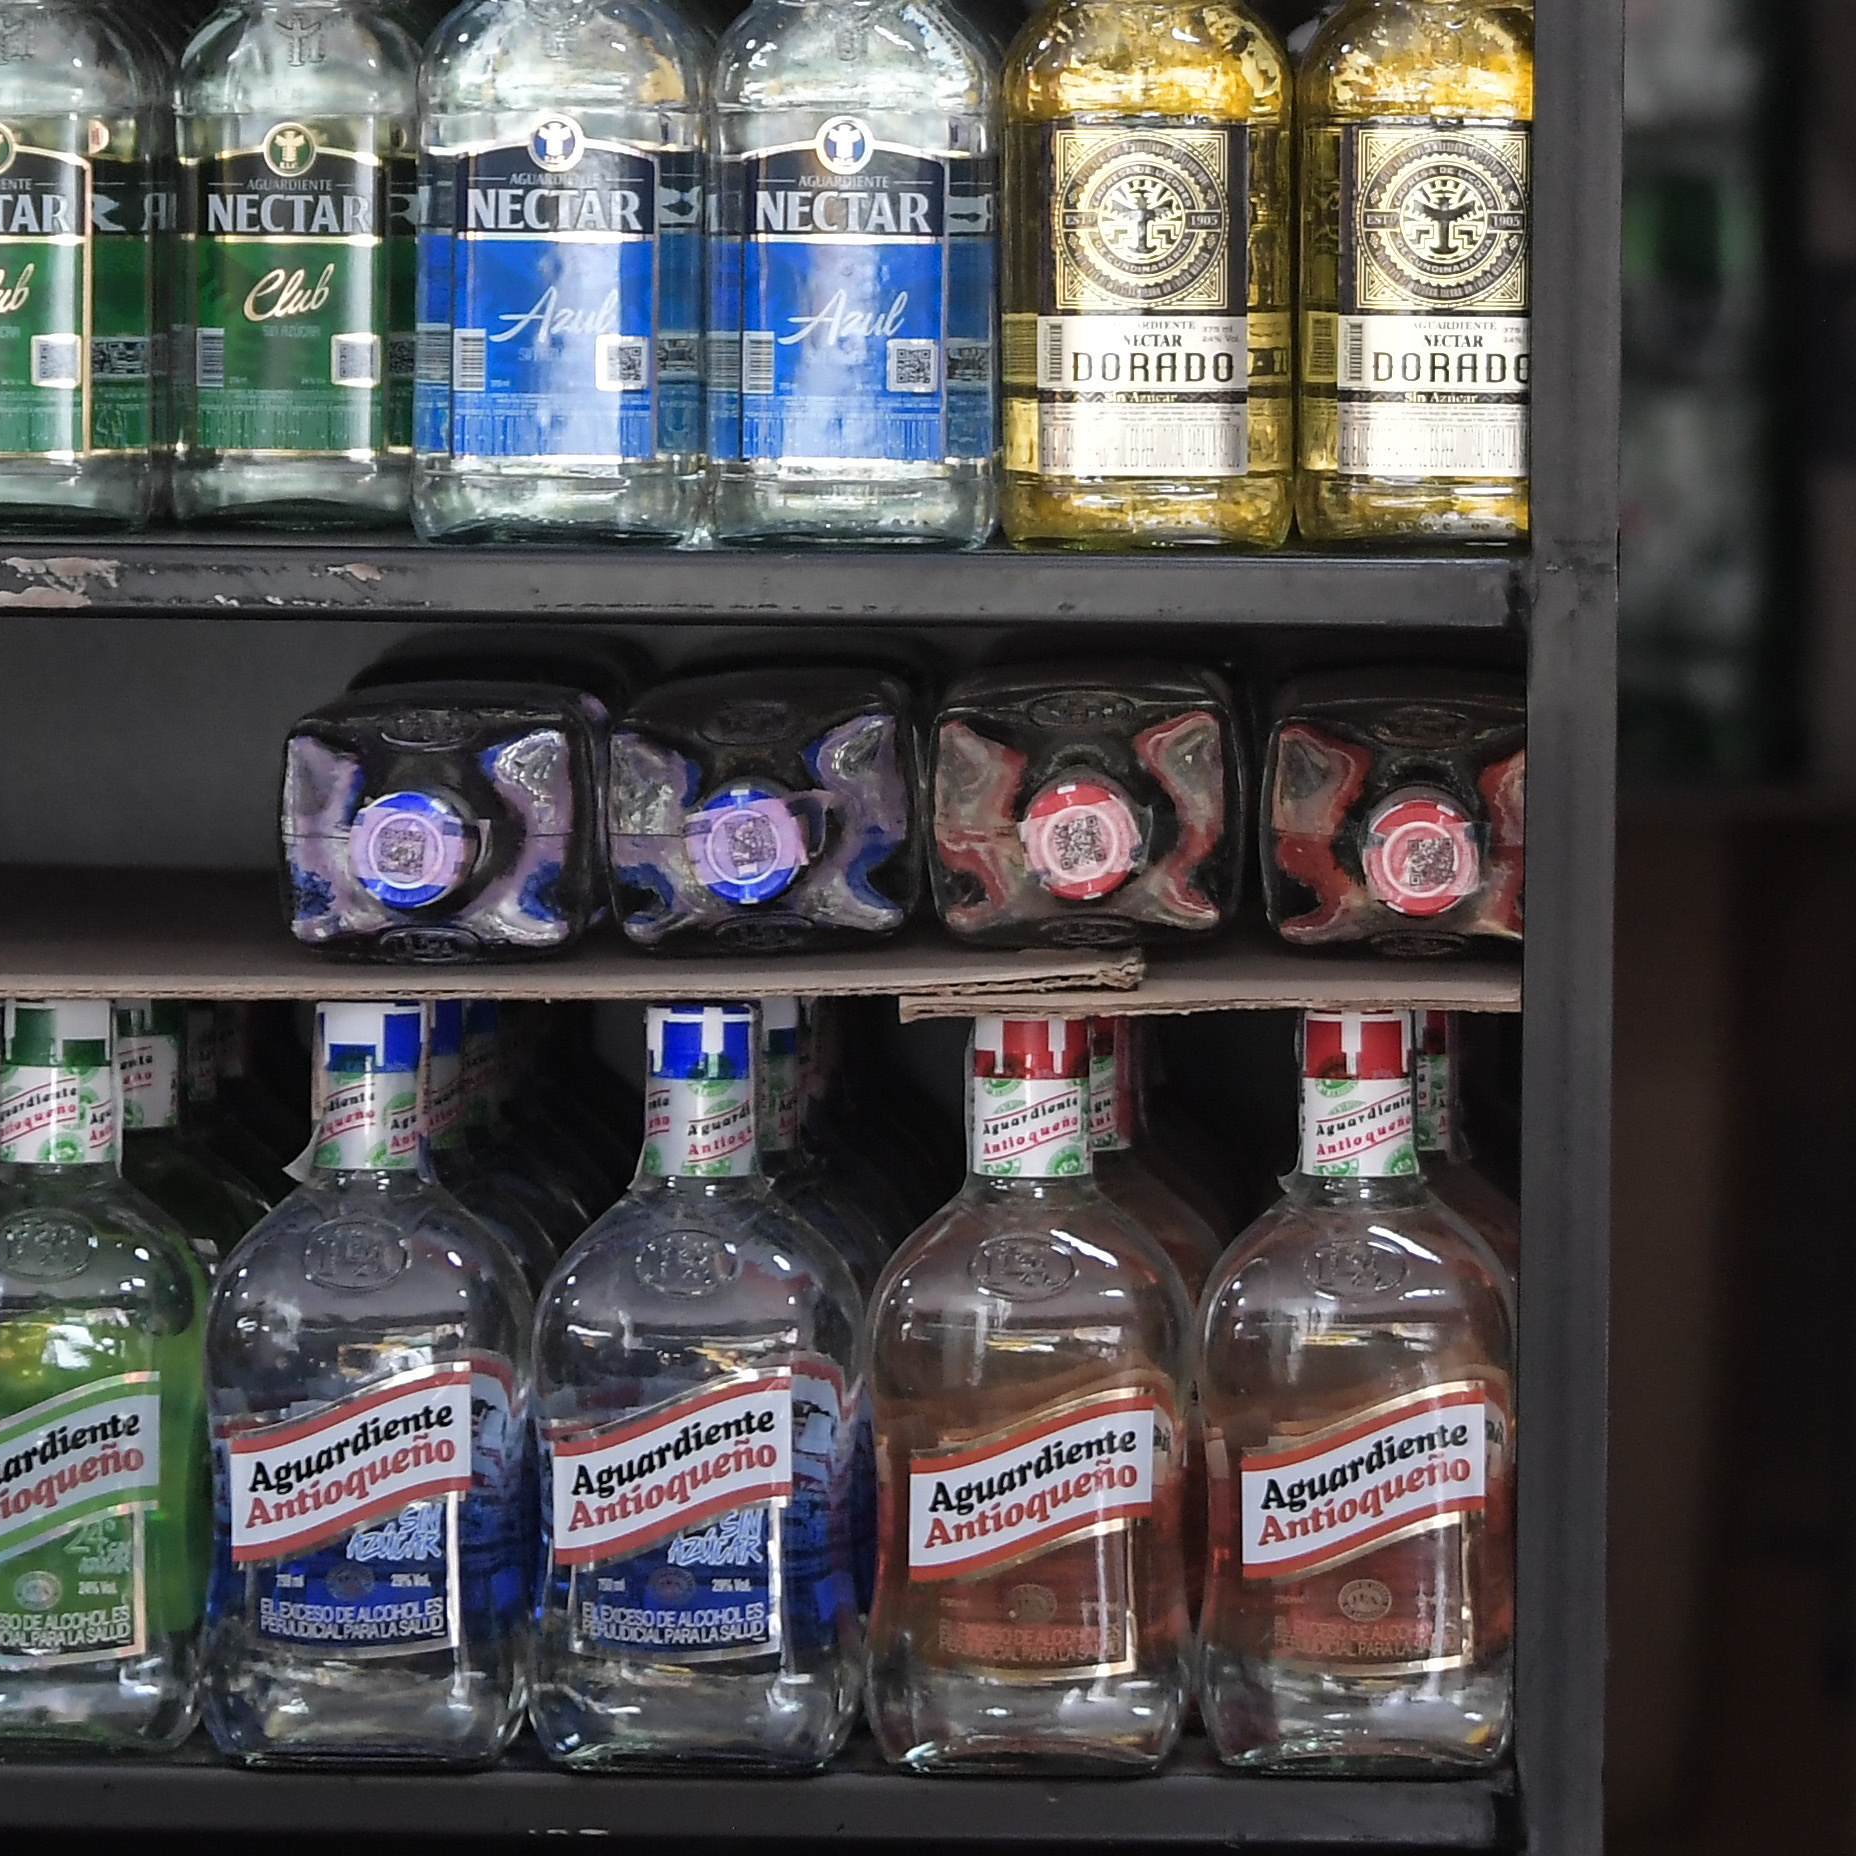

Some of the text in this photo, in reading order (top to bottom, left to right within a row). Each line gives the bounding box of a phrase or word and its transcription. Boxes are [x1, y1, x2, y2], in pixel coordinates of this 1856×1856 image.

[246, 178, 333, 193] AGUARDIENTE
[797, 175, 890, 189] AGUARDIENTE
[1457, 167, 1495, 209] LICORES
[207, 194, 373, 233] NECTAR
[466, 188, 642, 231] NECTAR
[756, 191, 932, 233] NECTAR
[1190, 214, 1219, 226] 1905
[1493, 214, 1521, 226] 1905
[1407, 238, 1494, 274] CUNDINAMARCA
[243, 263, 335, 324] Club
[489, 285, 620, 343] Azul
[777, 287, 908, 345] Azul
[1423, 334, 1484, 348] NECTAR
[1071, 351, 1234, 383] DORADO
[1103, 391, 1124, 404] Sin
[1404, 392, 1429, 404] Sin
[982, 1095, 1080, 1137] Aguardiente
[982, 1114, 1080, 1156] Antioqueño
[1315, 1095, 1412, 1138] Aguardiente
[1315, 1114, 1413, 1156] Antioqueño
[247, 1403, 454, 1495] Aguardiente
[570, 1407, 775, 1499] Aguardiente
[1259, 1423, 1469, 1512] Aguardiente
[243, 1434, 456, 1529] Antioqueño
[567, 1438, 778, 1532] Antioqueño
[927, 1428, 1138, 1515] Aguardiente
[398, 1502, 443, 1533] SIN
[924, 1458, 1139, 1549] Antioqueño
[1256, 1453, 1472, 1546] Antioqueño
[719, 1508, 764, 1539] SIN
[582, 1601, 765, 1628] EL EXCESO DE ALCOHOL ES
[665, 1628, 701, 1644] PARA
[701, 1627, 720, 1643] LA
[720, 1620, 766, 1641] SALUD
